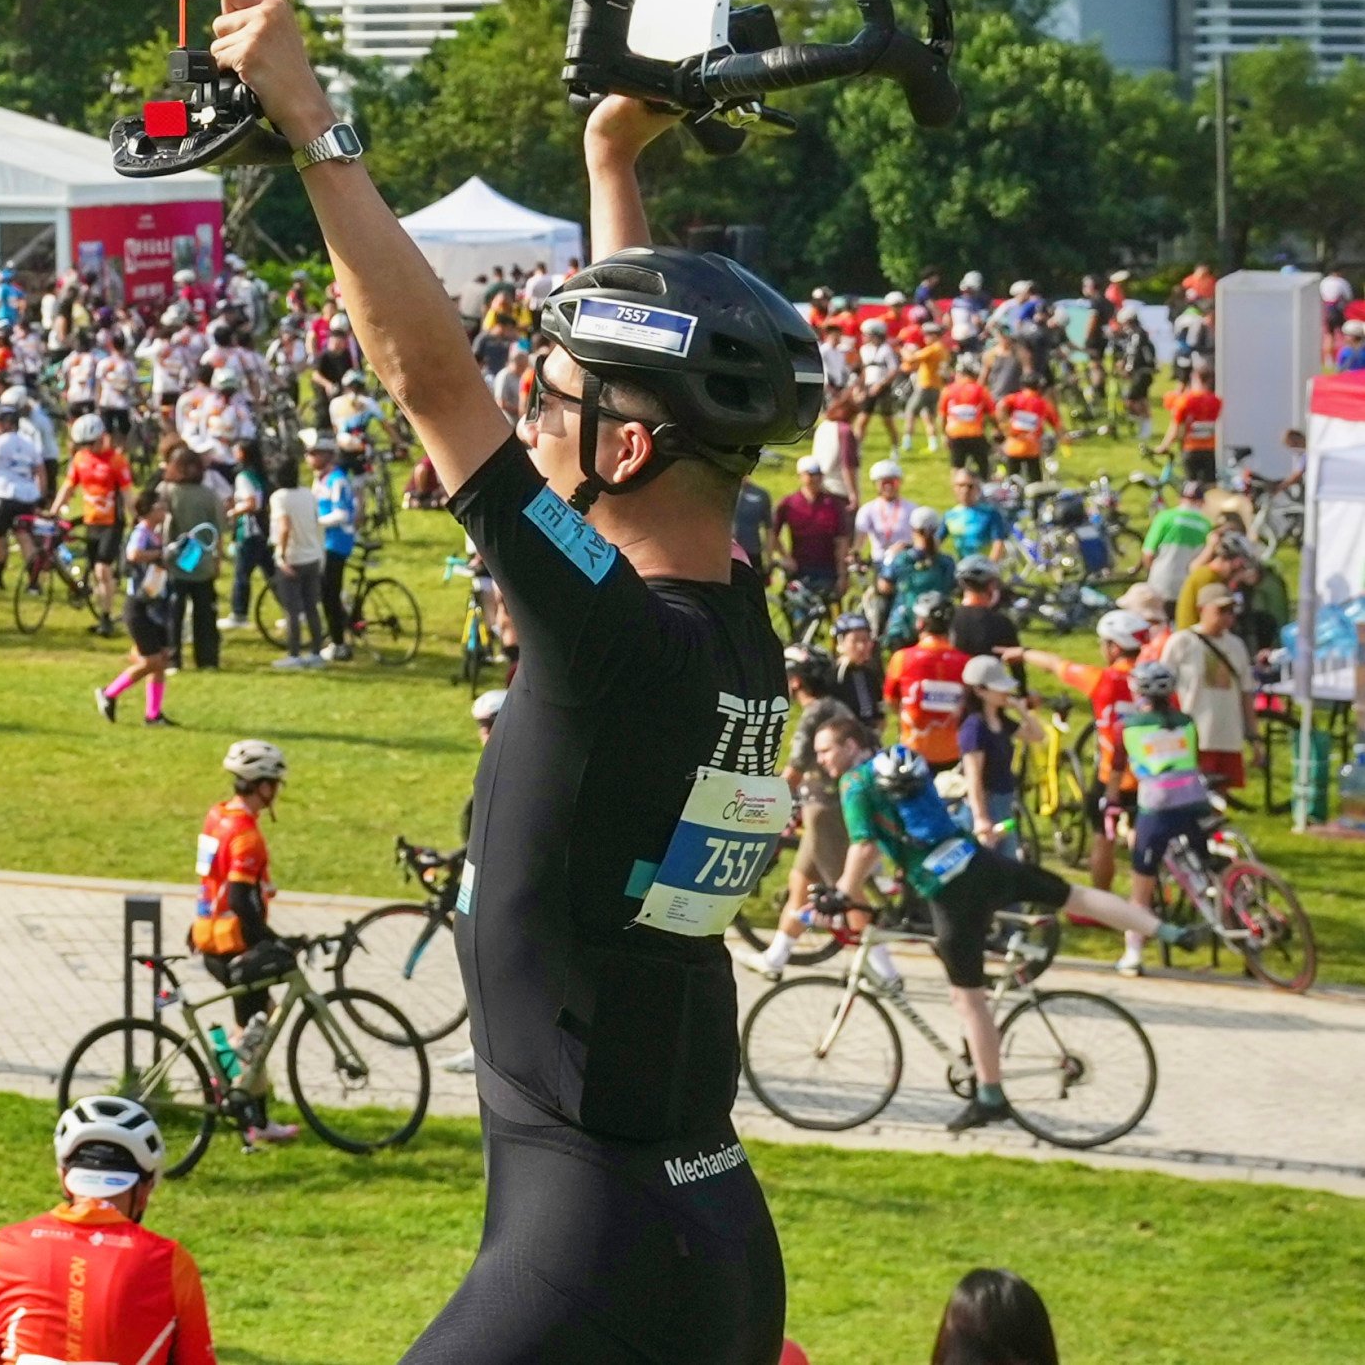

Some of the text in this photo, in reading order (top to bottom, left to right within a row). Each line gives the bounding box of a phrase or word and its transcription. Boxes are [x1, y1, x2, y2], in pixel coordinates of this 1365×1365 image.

[616, 306, 650, 324] 7557
[695, 837, 767, 888] 7557
[664, 1143, 747, 1186] Mechanism
[70, 1256, 86, 1285] NO
